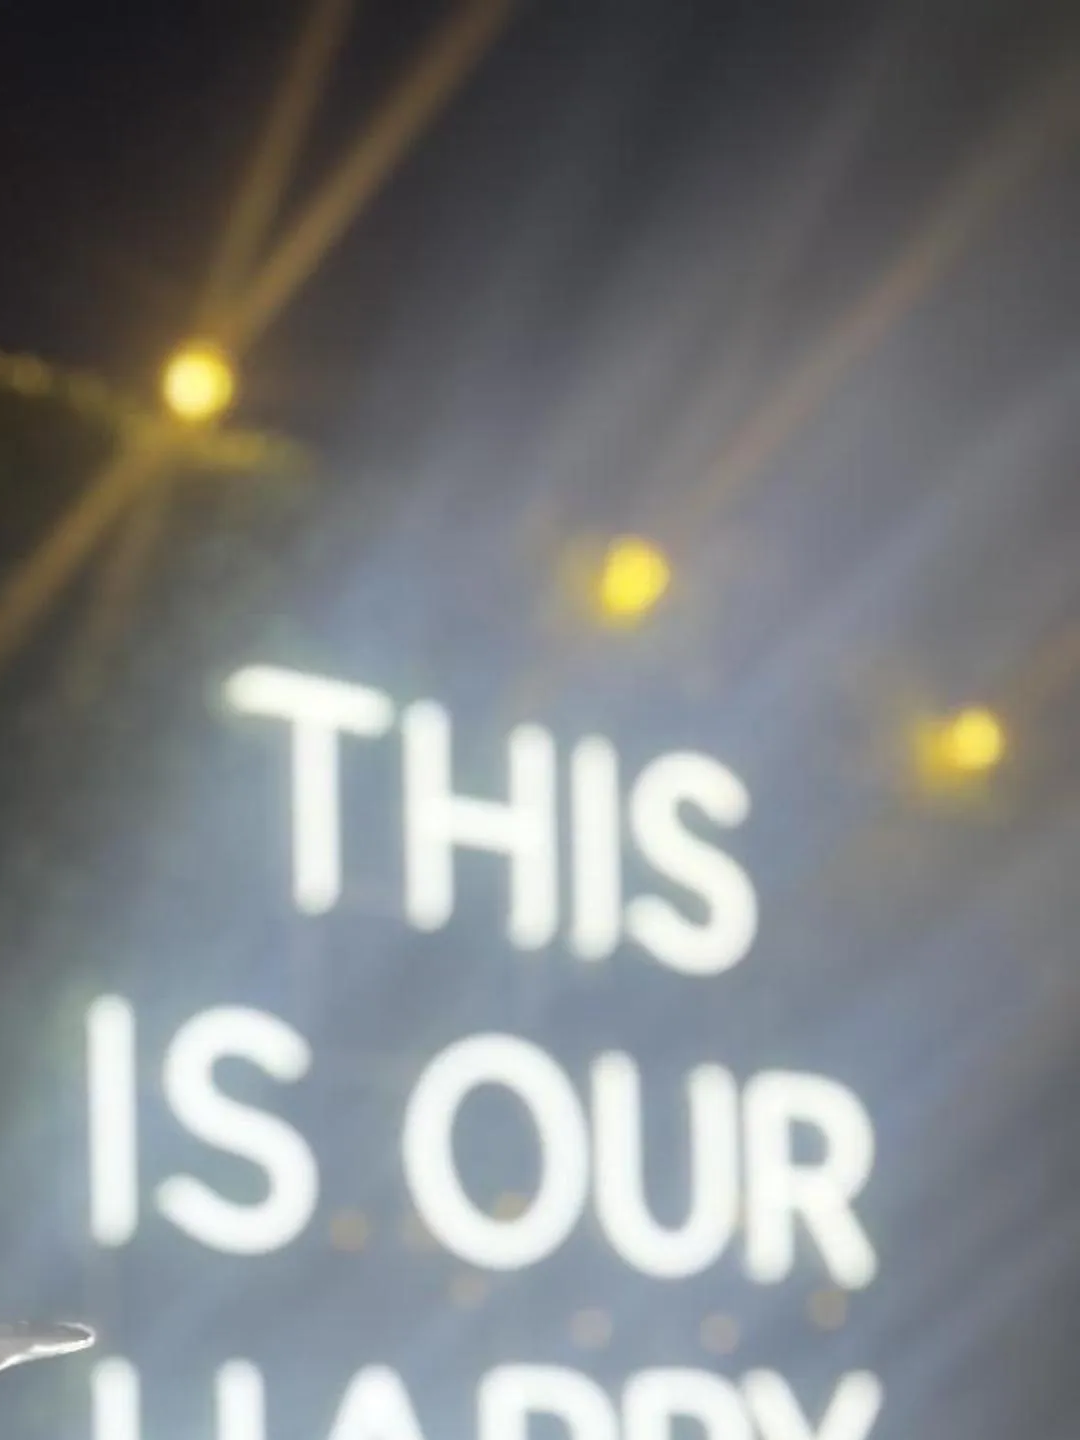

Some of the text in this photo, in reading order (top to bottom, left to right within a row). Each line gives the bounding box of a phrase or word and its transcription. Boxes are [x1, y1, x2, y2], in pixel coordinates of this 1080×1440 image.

[225, 665, 758, 973] THIS
[88, 996, 874, 1287] IS OUR
